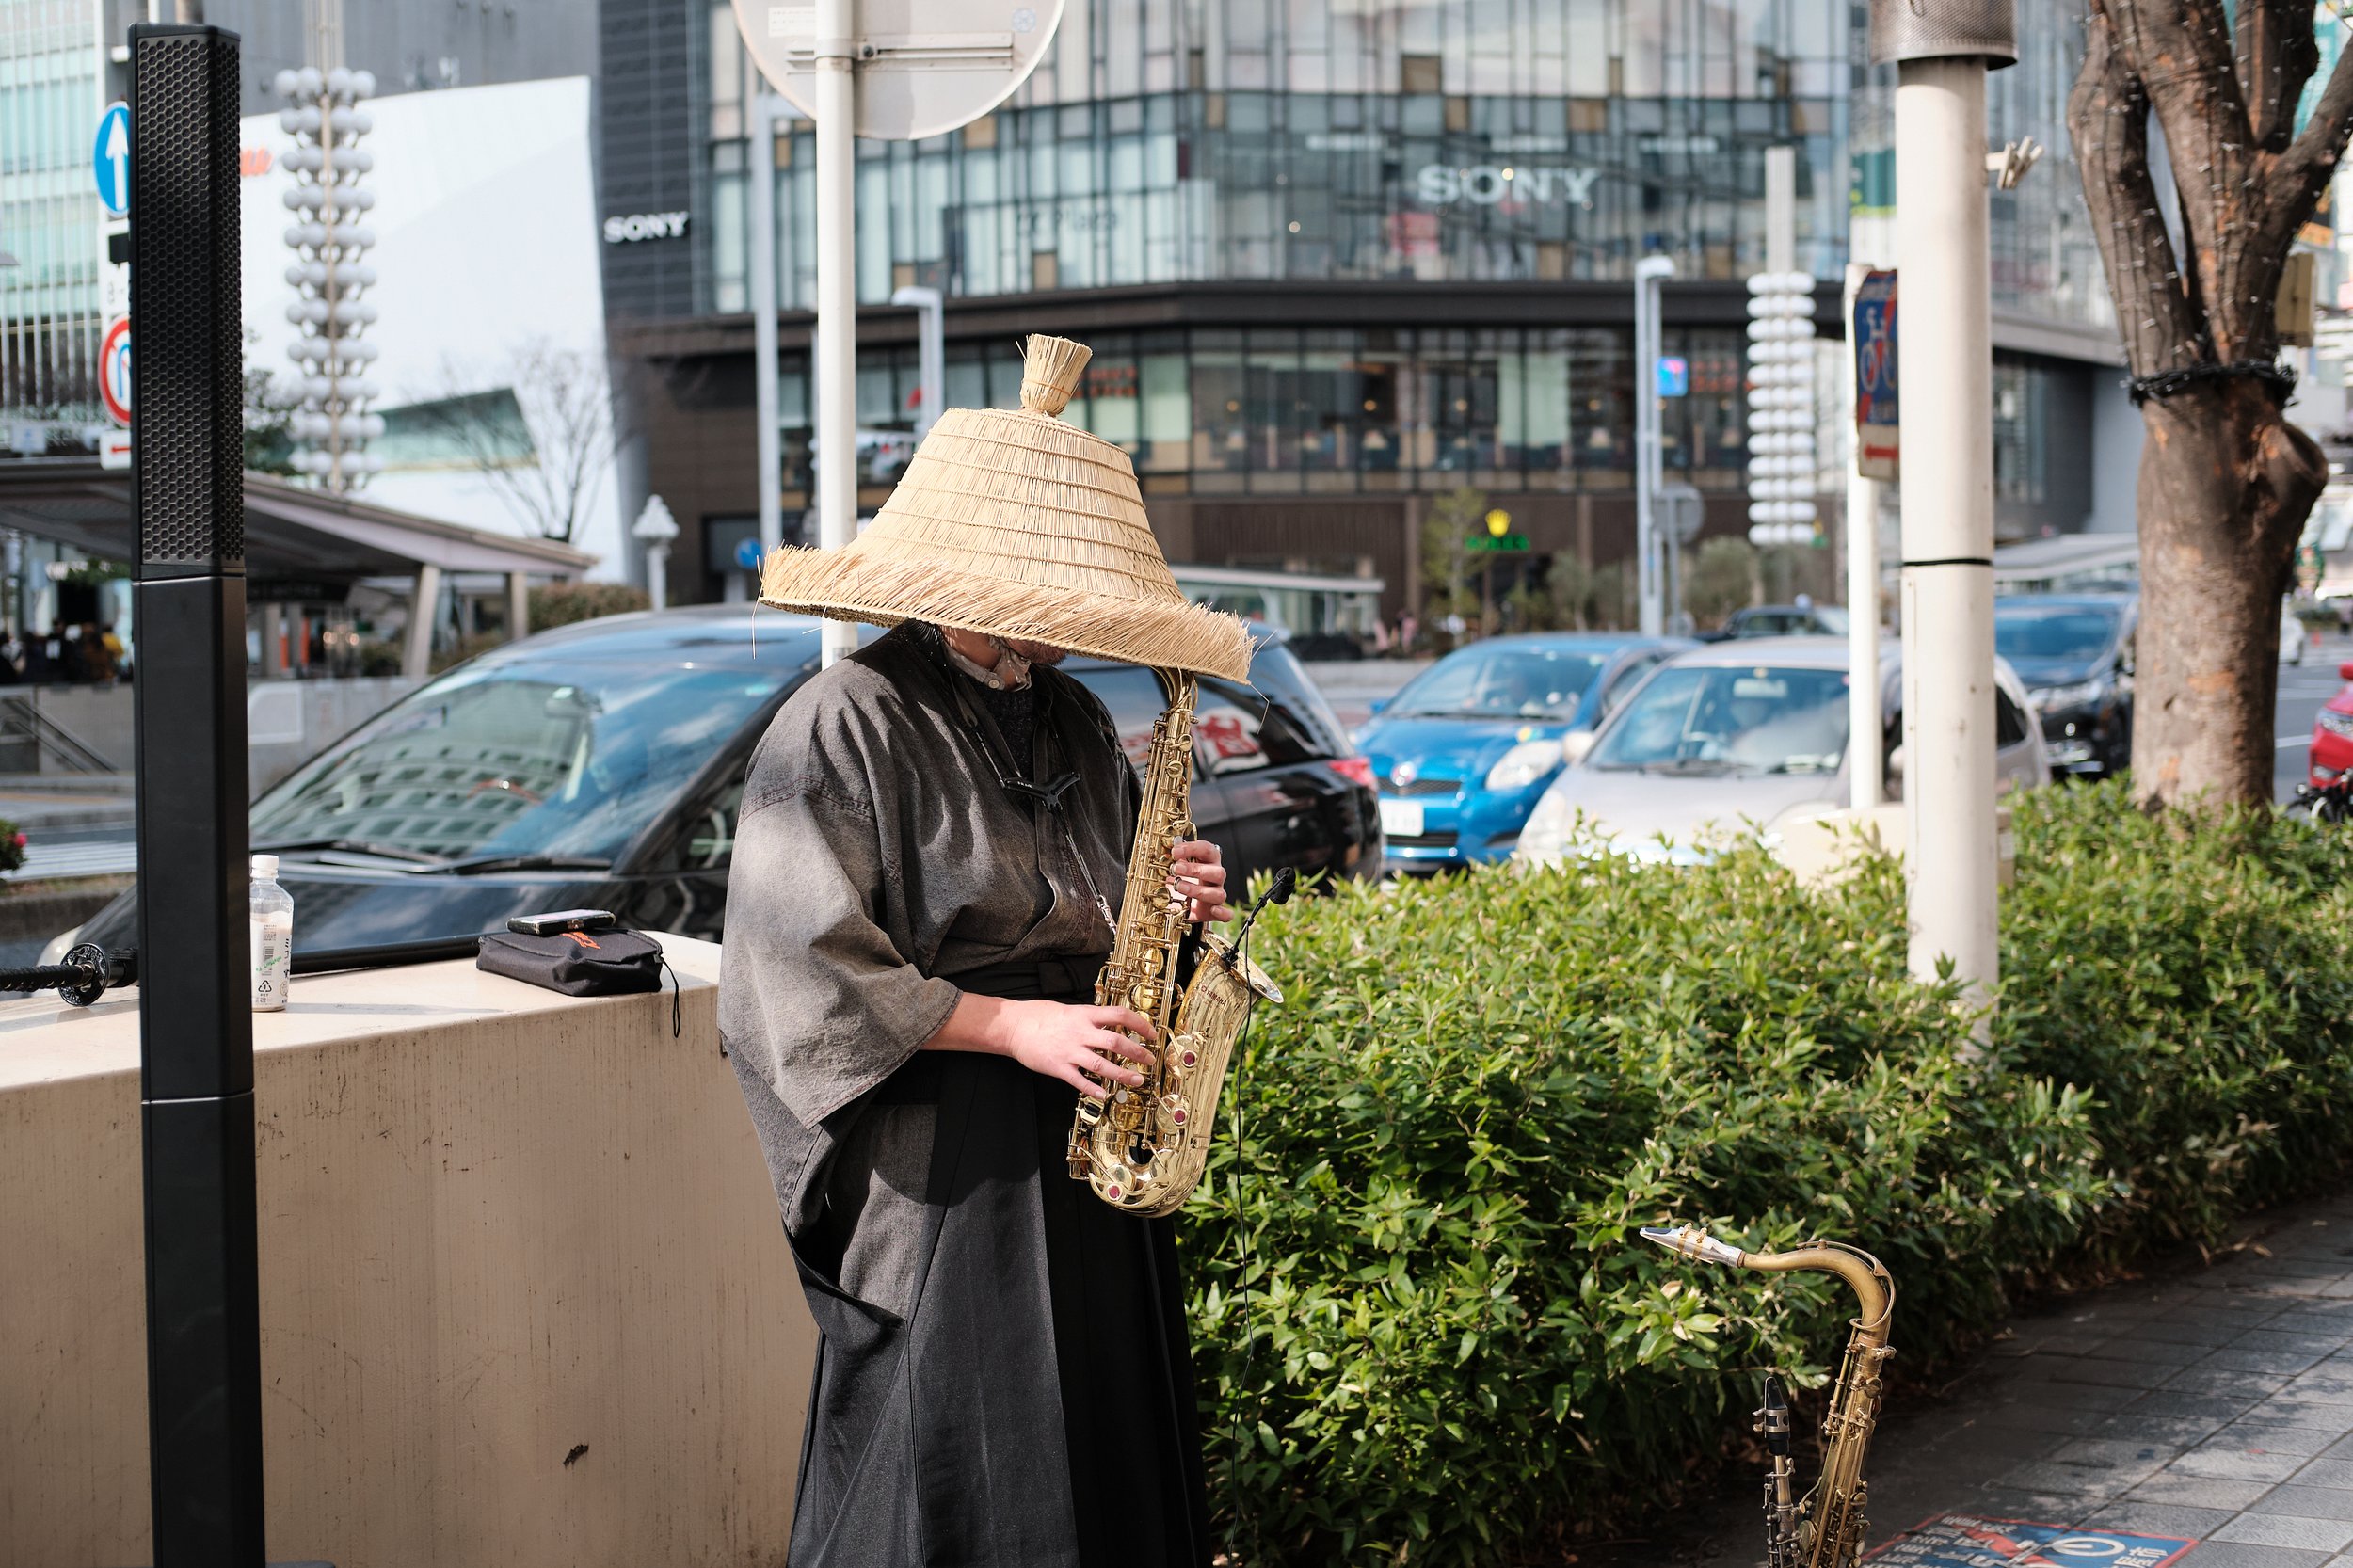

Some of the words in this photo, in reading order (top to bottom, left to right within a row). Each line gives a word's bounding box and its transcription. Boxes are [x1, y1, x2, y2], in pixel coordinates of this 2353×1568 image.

[1417, 164, 1597, 205] SONY
[603, 211, 689, 243] SONY
[1206, 989, 1227, 1006] YAMAHA
[2101, 1546, 2169, 1568] 屋市
